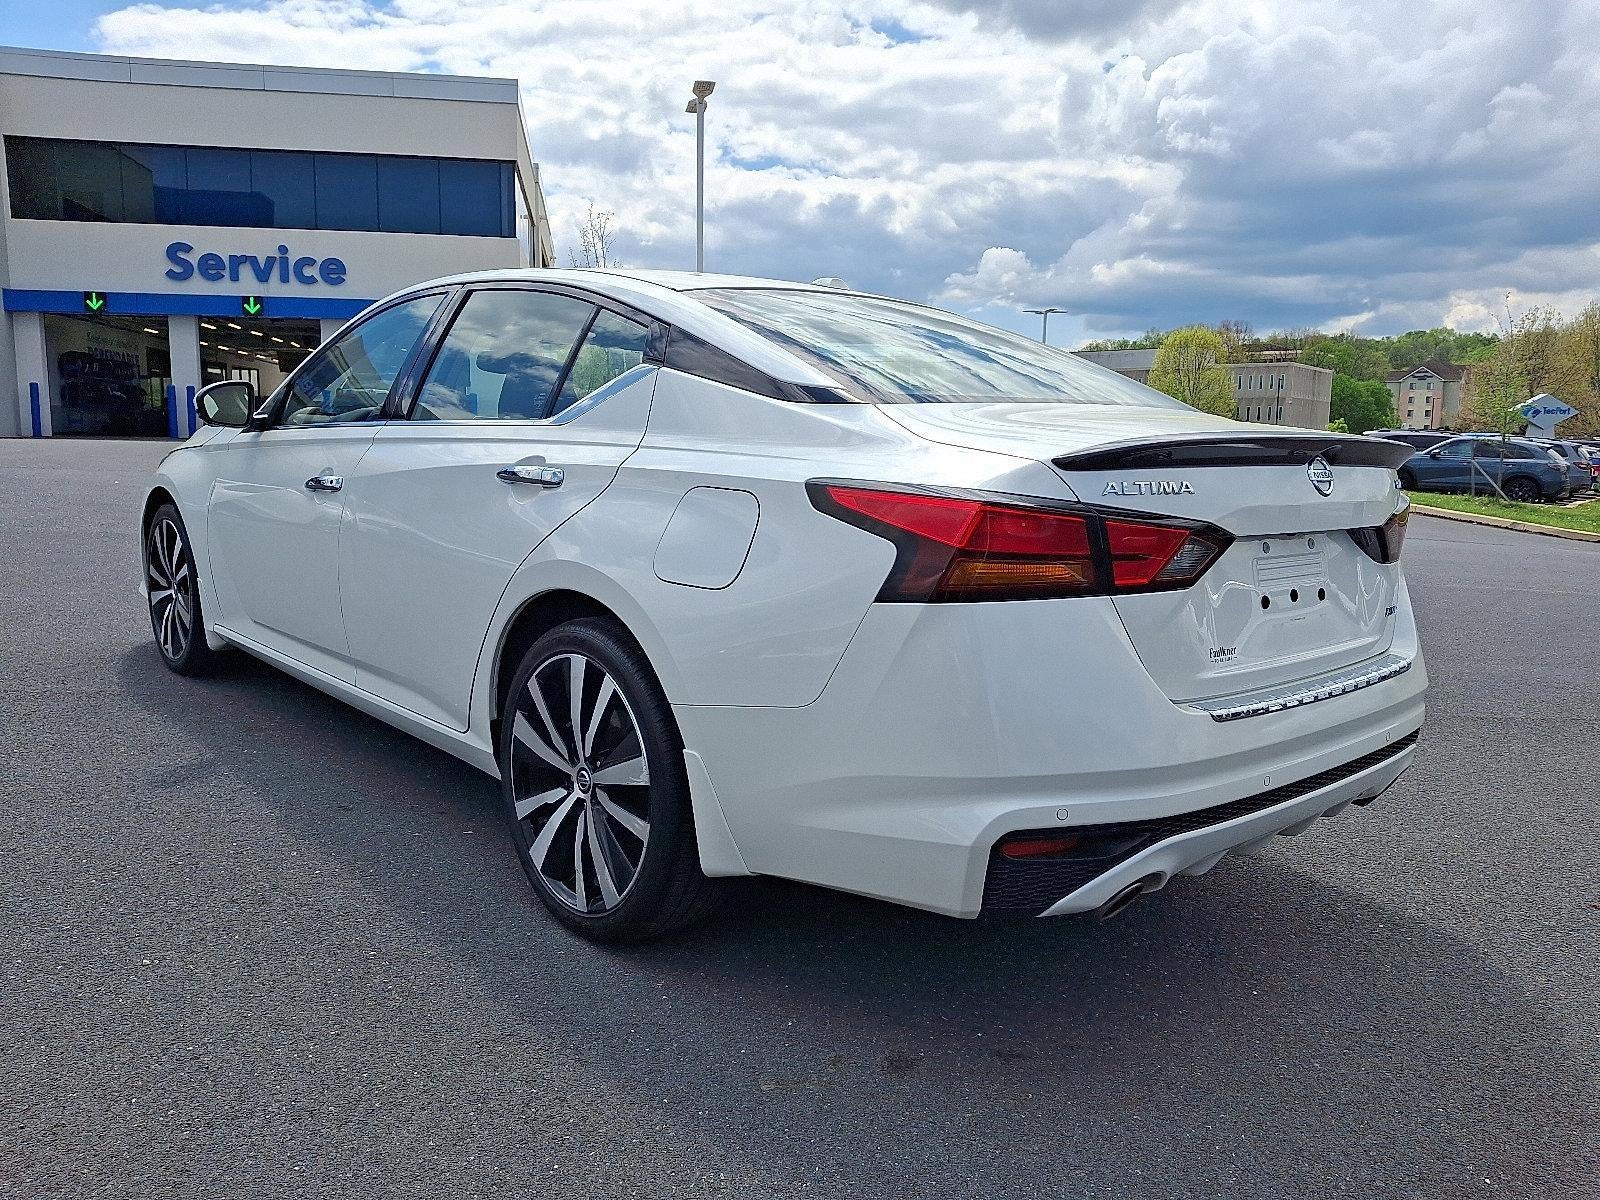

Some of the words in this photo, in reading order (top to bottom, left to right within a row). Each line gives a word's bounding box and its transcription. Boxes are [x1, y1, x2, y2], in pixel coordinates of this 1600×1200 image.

[165, 242, 347, 286] Service
[1543, 406, 1571, 415] TecPort
[1102, 481, 1195, 496] ALTIMA
